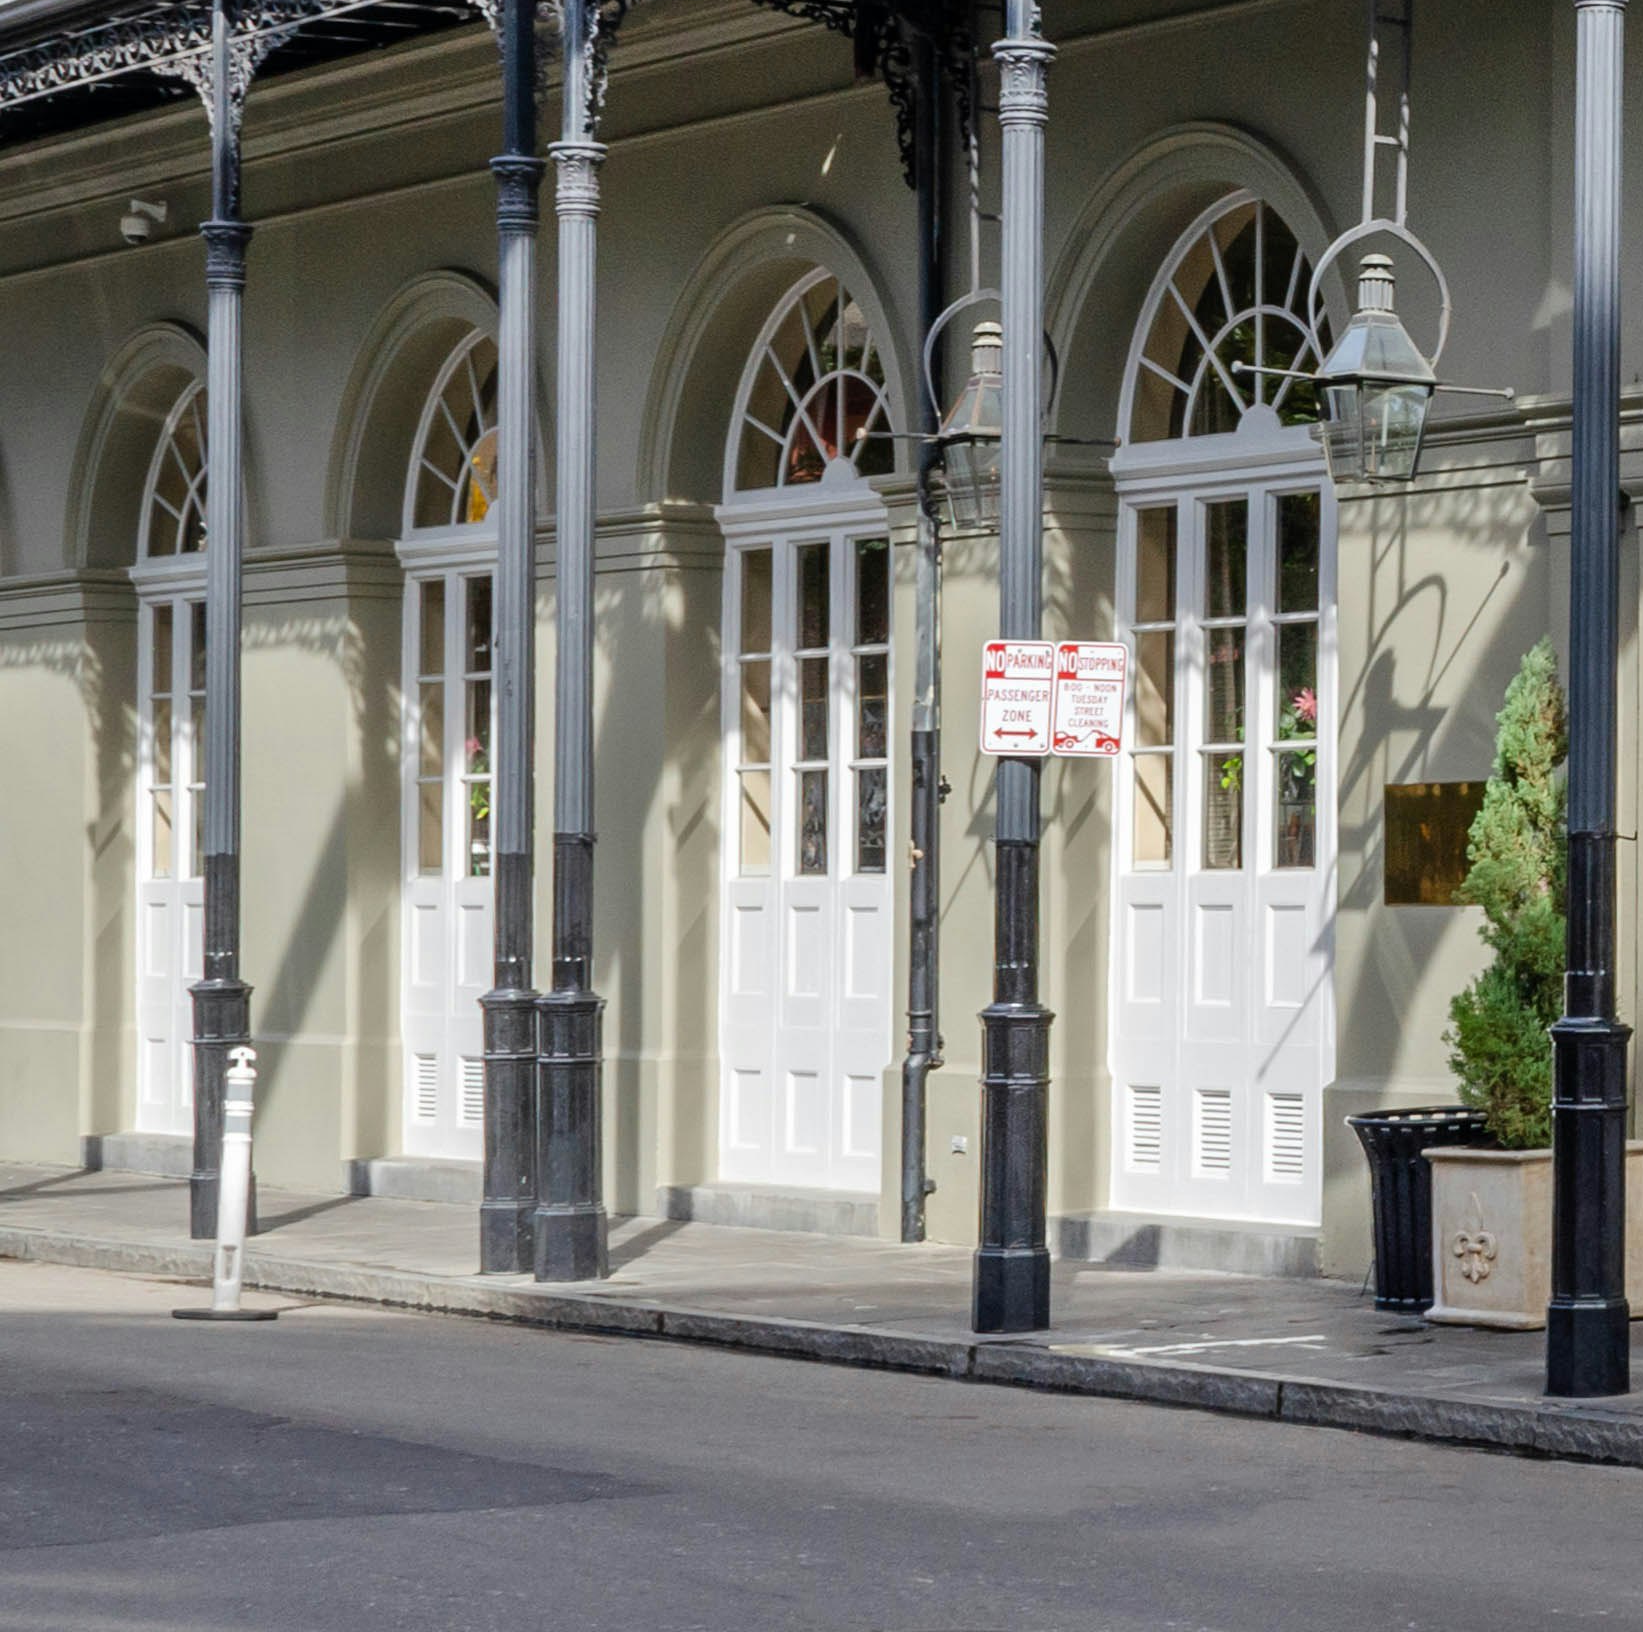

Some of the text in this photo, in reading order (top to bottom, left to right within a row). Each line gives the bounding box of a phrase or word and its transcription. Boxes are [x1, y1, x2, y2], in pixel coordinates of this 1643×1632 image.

[986, 650, 1052, 672] NO PARKING
[1059, 650, 1123, 672] NO STOPPING
[1094, 684, 1117, 692] NOON
[988, 688, 1048, 702] PASSENGER
[1072, 695, 1108, 704] TUESDAY
[1002, 710, 1032, 722] ZONE
[1074, 707, 1104, 716] STREET
[1068, 718, 1108, 727] CLEANING
